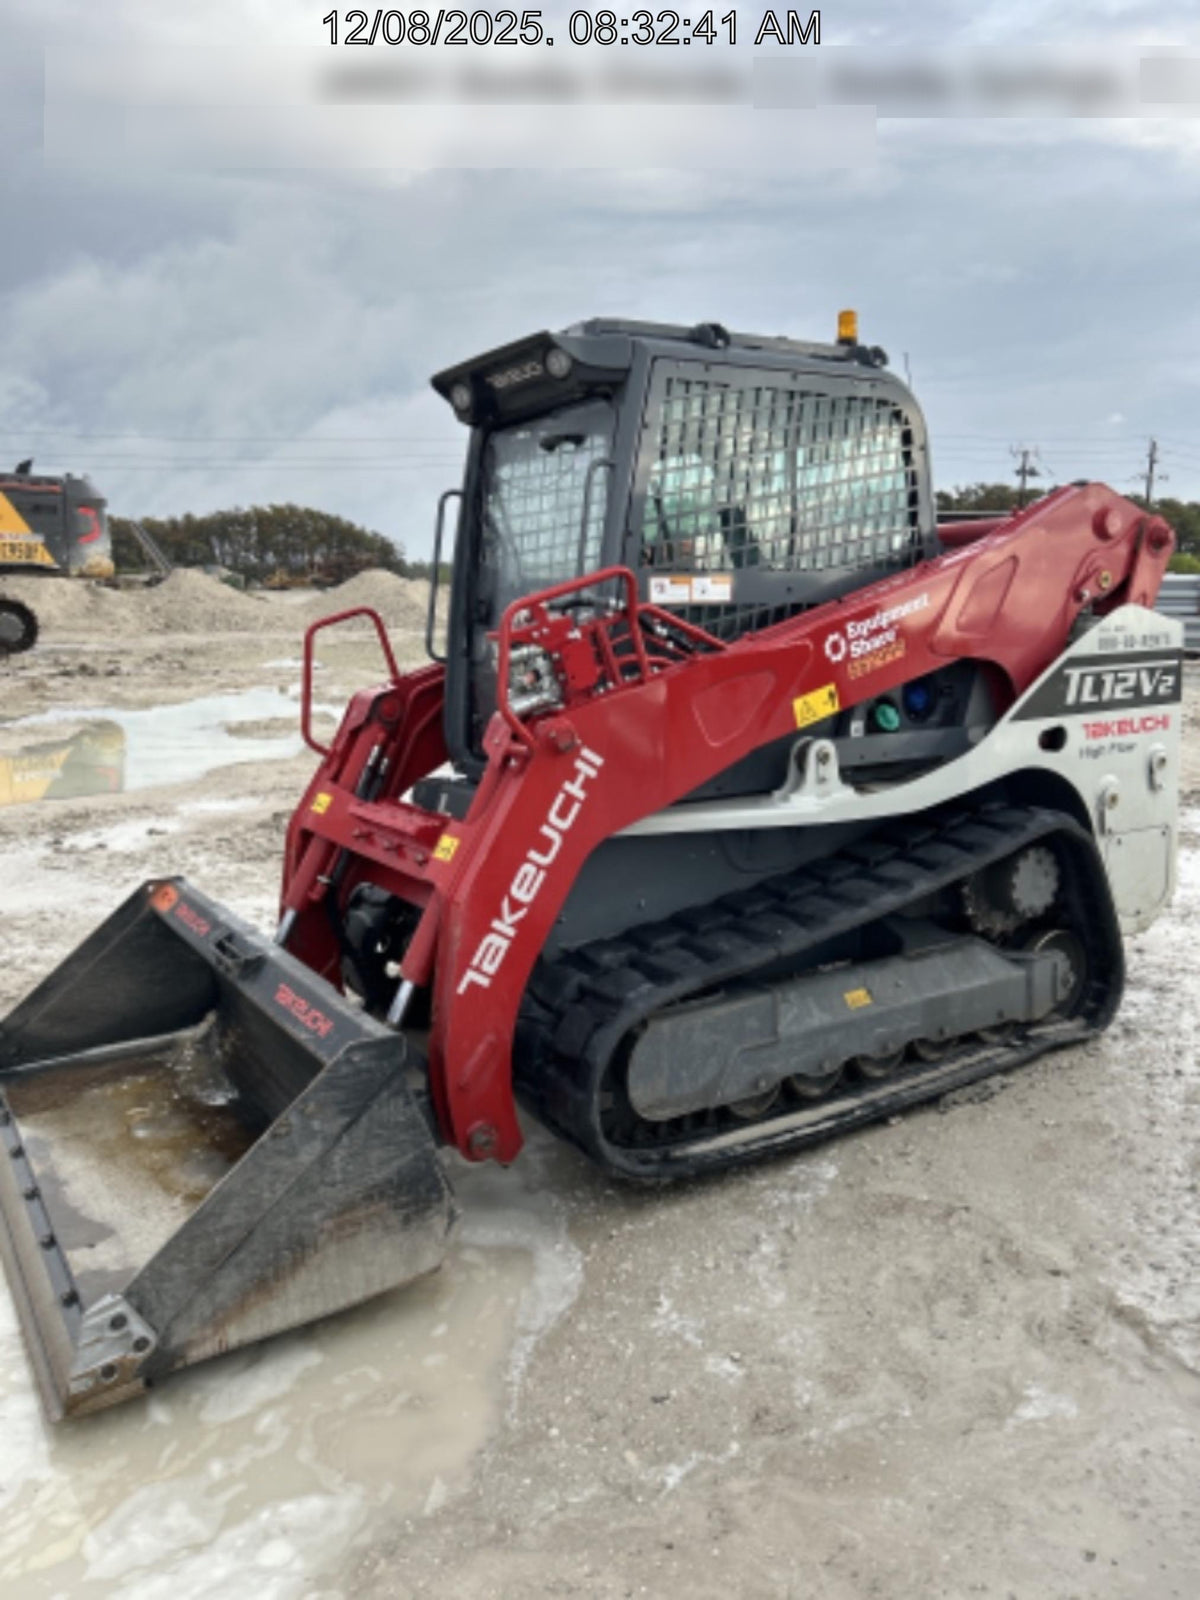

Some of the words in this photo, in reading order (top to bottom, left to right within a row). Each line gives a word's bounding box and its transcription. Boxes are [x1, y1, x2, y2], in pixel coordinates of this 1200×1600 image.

[1064, 666, 1176, 706] TL12V2
[1082, 714, 1171, 740] TAKEUCHI
[456, 747, 605, 995] TAKEUCHI
